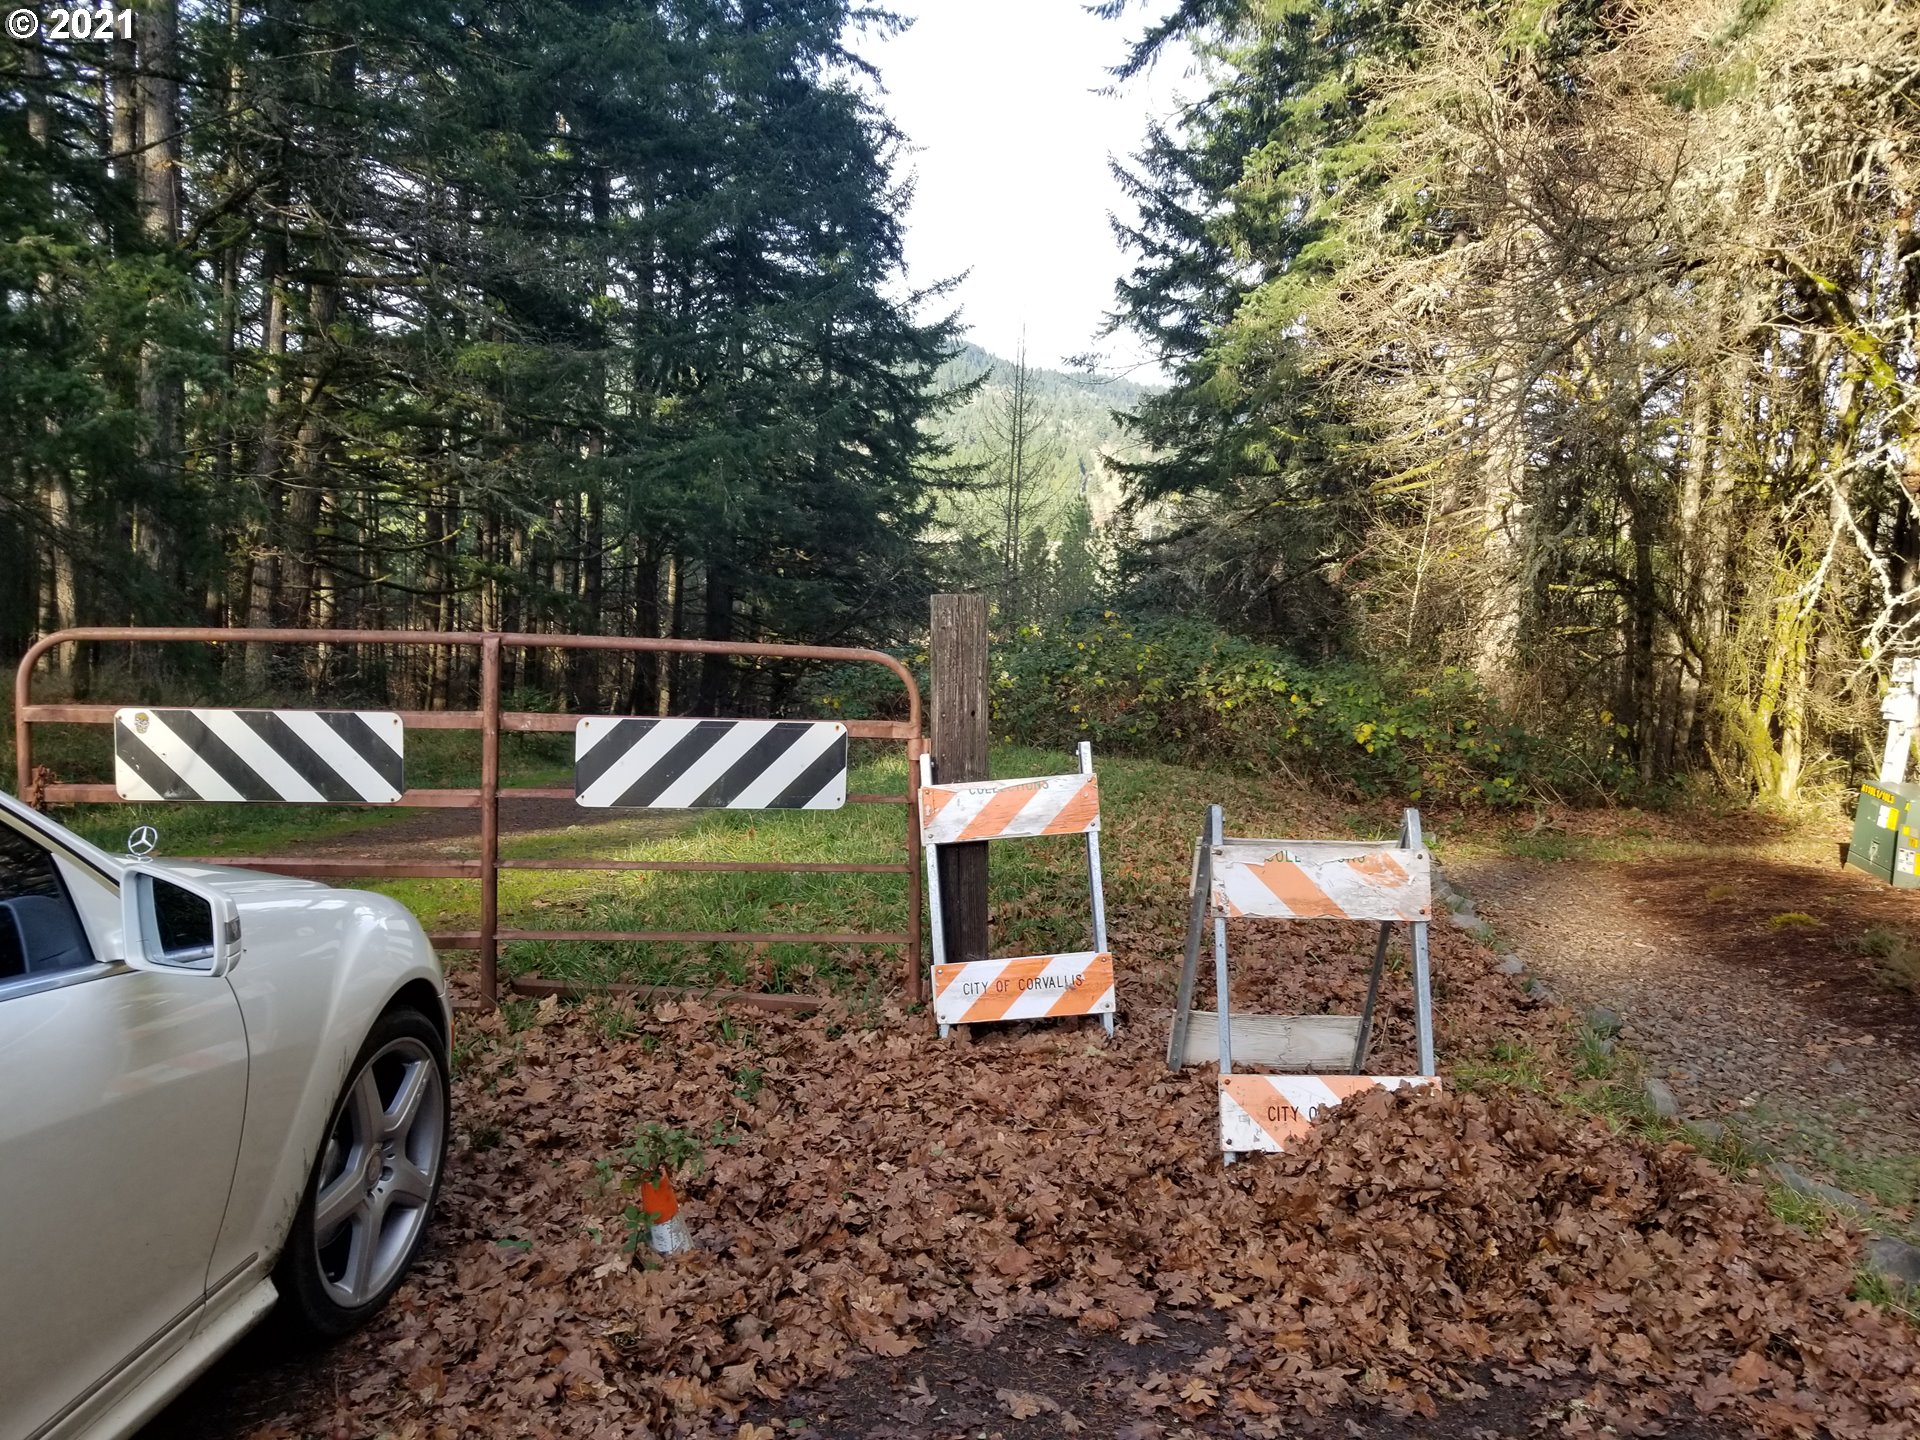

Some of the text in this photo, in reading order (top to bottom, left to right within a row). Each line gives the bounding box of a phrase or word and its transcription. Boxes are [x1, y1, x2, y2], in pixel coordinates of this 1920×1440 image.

[963, 974, 1084, 996] CITY OF CORVALLIS
[1267, 1105, 1299, 1122] CITY
